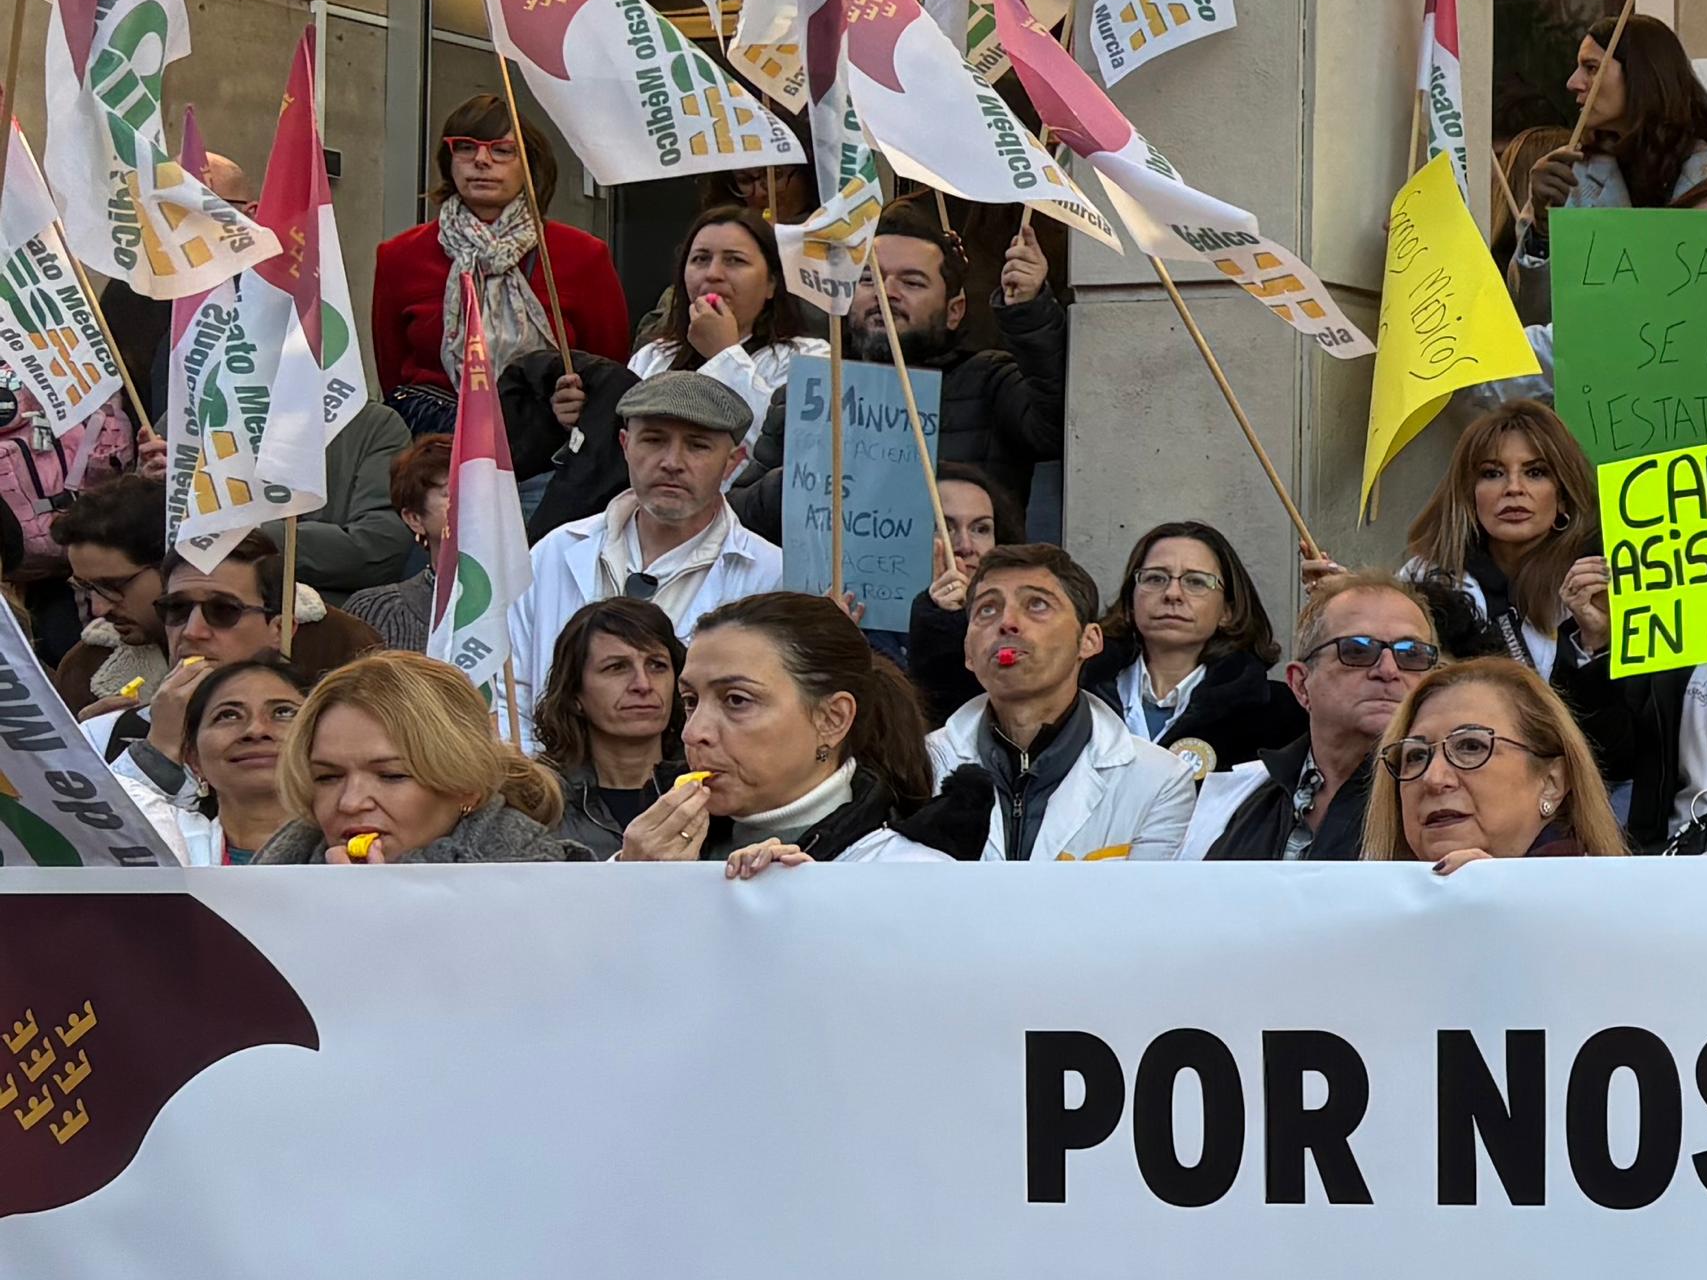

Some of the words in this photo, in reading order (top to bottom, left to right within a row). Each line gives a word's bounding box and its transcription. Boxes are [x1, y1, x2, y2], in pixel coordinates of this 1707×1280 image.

[1095, 4, 1124, 70] Murcia
[1581, 228, 1639, 289] LA
[56, 288, 119, 378] Médico
[1636, 321, 1681, 371] SE
[21, 355, 66, 423] Murcia
[801, 378, 825, 421] 5
[1619, 606, 1684, 664] EN
[1025, 1028, 1373, 1209] POR
